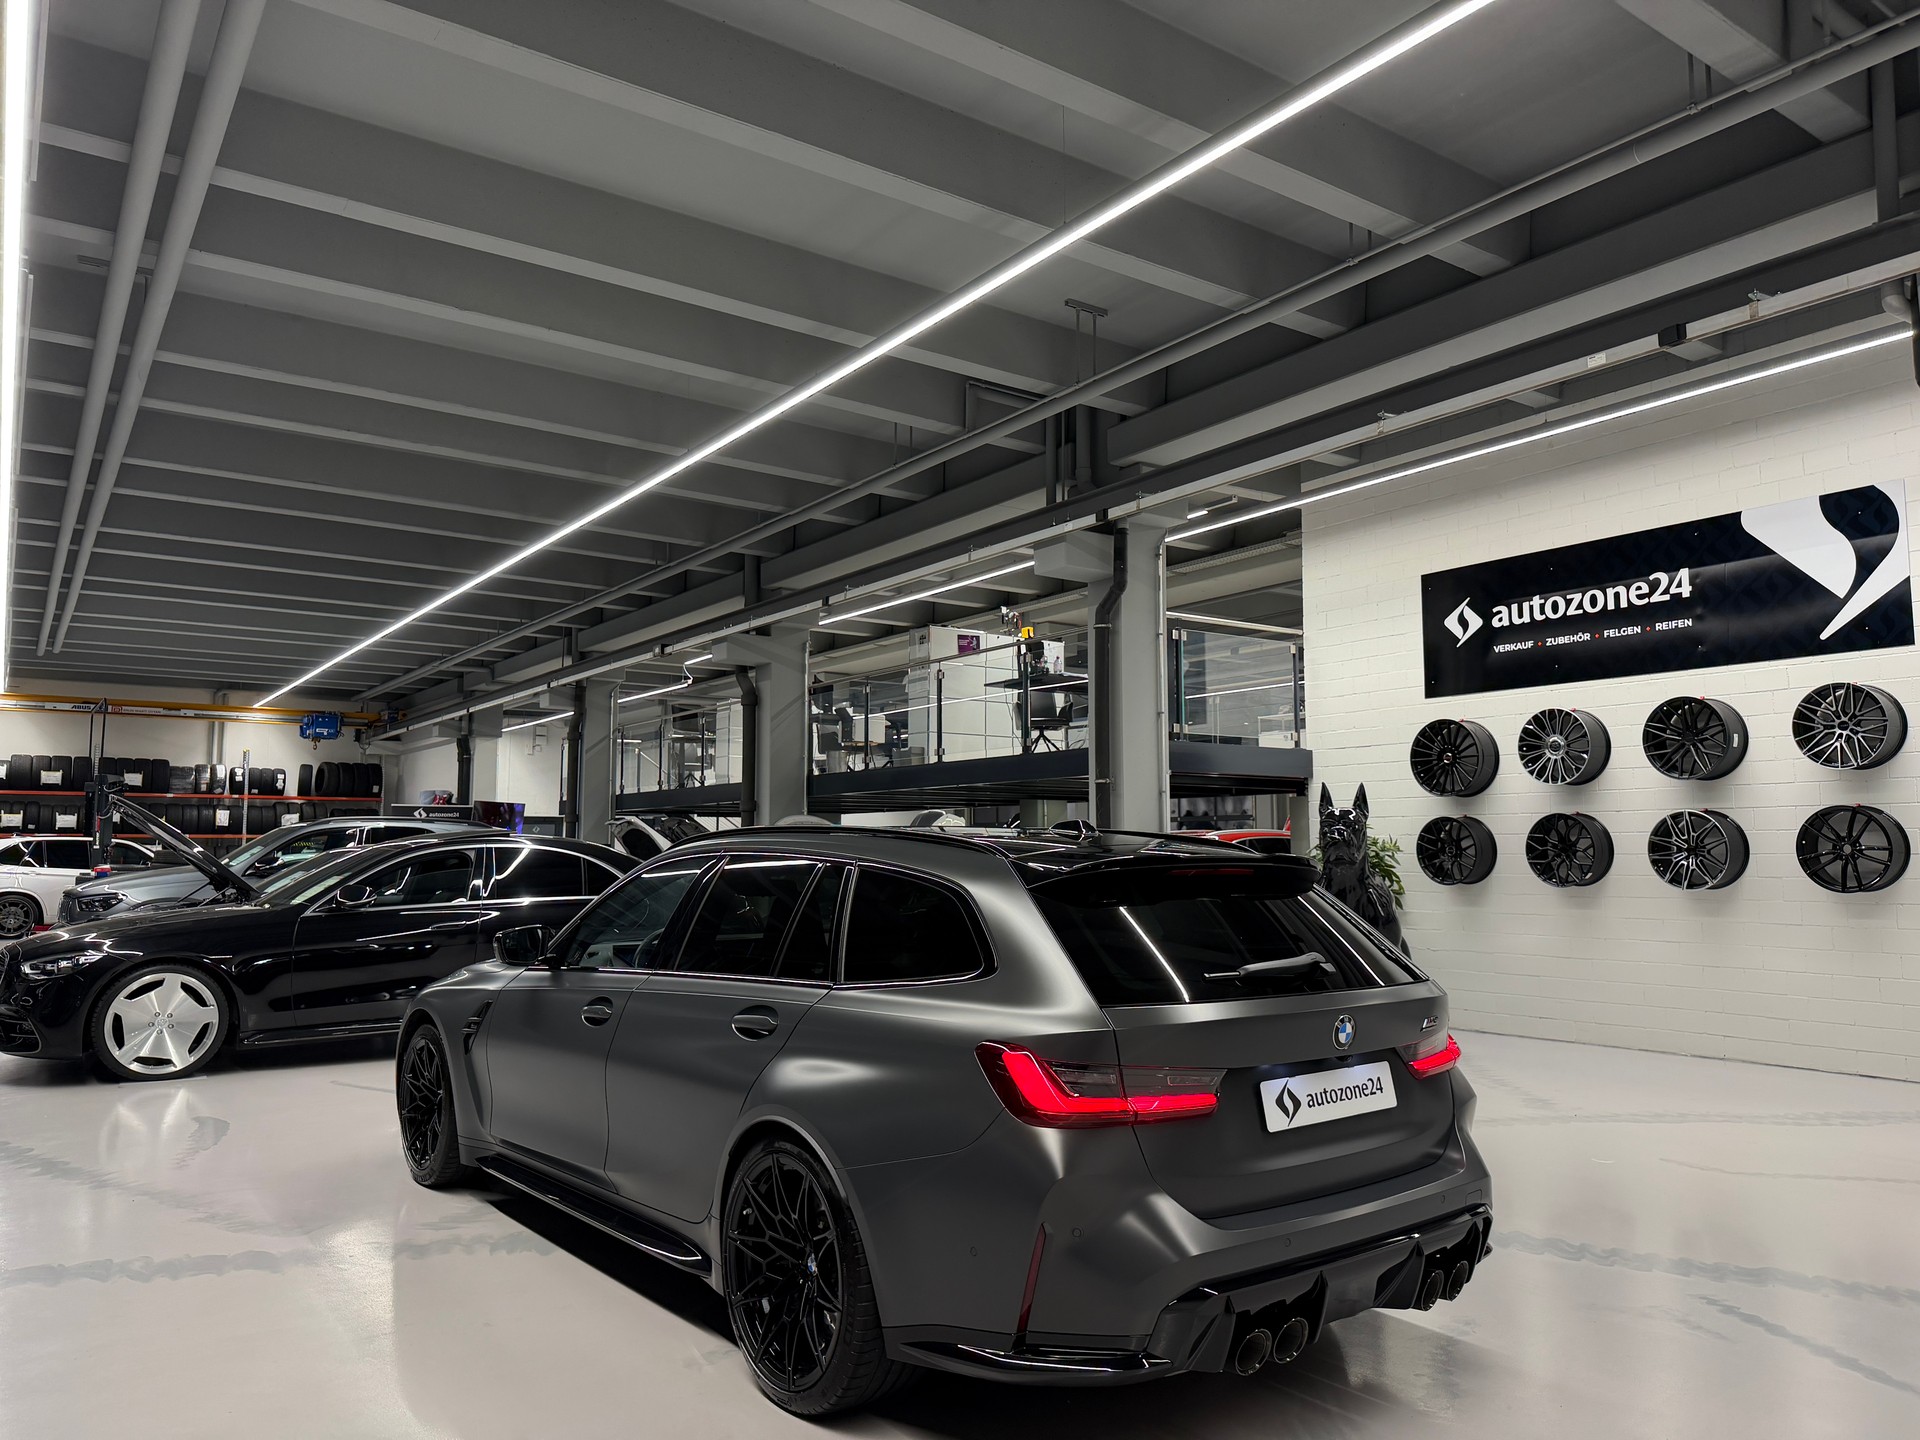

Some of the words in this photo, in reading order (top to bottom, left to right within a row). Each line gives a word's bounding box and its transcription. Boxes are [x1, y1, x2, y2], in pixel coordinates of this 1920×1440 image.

[1491, 567, 1692, 628] autozone24
[1493, 640, 1535, 653] VERKAUF
[1545, 632, 1591, 646] ZUBEHÖR
[1603, 625, 1642, 638] FELGEN
[1655, 618, 1693, 631] REIFEN
[1306, 1076, 1383, 1108] autozone24
